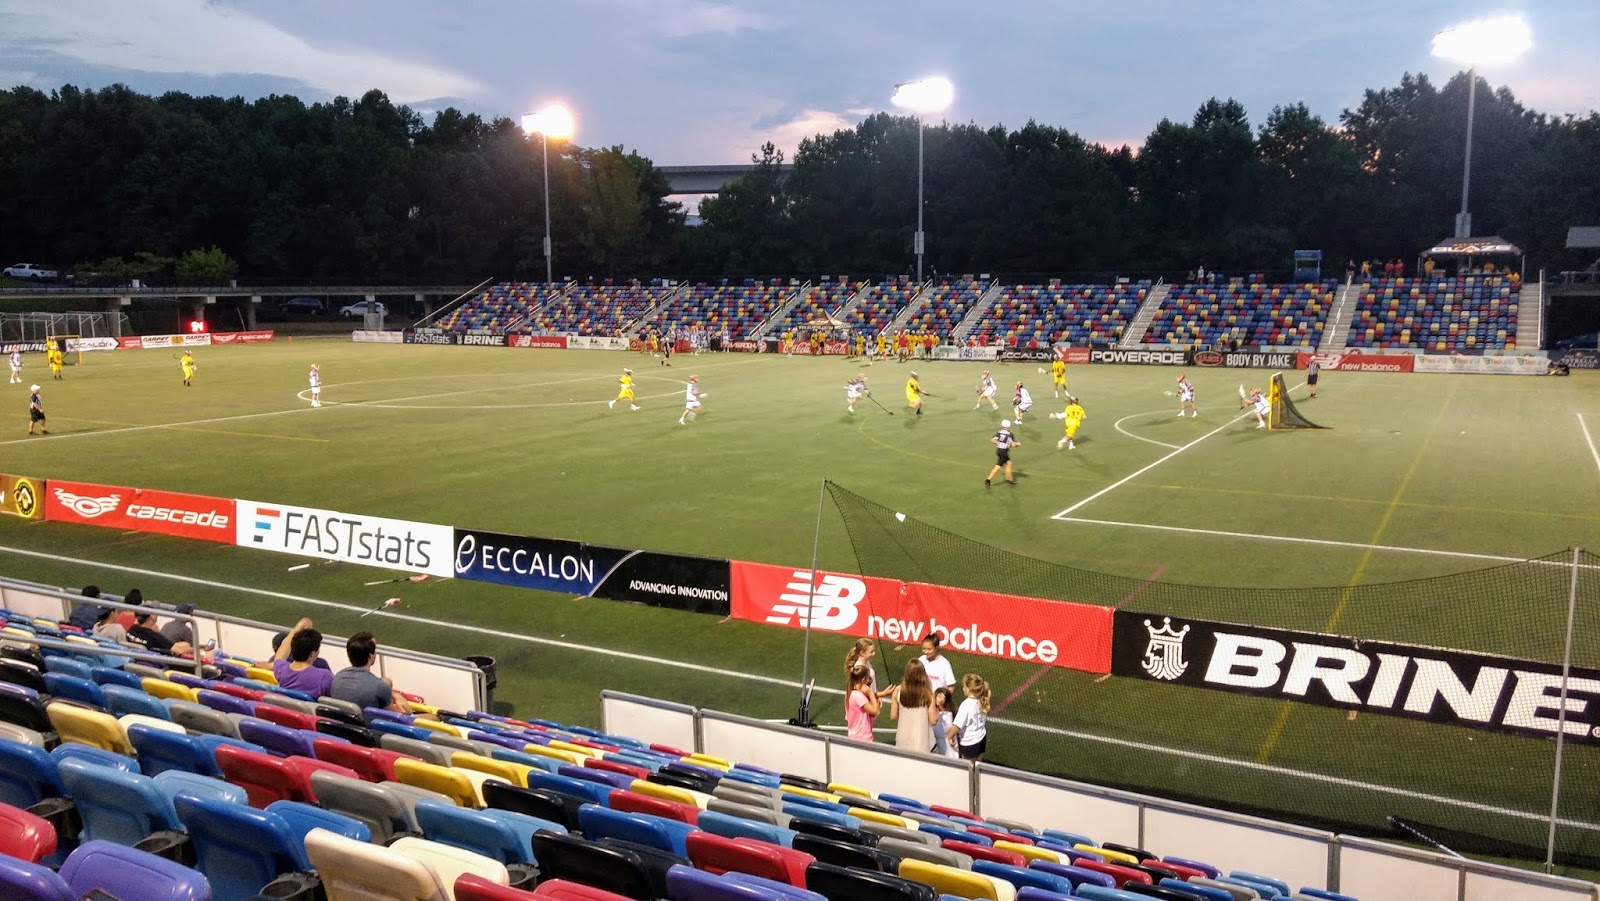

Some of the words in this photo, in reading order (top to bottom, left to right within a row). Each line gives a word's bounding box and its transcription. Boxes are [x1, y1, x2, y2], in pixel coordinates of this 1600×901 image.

[414, 332, 450, 344] FASTstats
[464, 335, 505, 346] BRINE
[1226, 354, 1251, 366] BODY
[1253, 355, 1265, 366] BY
[1267, 355, 1291, 367] JAKE
[1361, 362, 1400, 371] balance
[125, 503, 229, 529] cascade
[284, 512, 431, 568] FASTstats
[483, 545, 594, 583] ECCALON
[629, 580, 677, 595] ADVANCING
[677, 584, 728, 601] INNOVATION
[867, 615, 924, 642] new
[930, 618, 1058, 663] balance
[1203, 631, 1600, 736] BRINE
